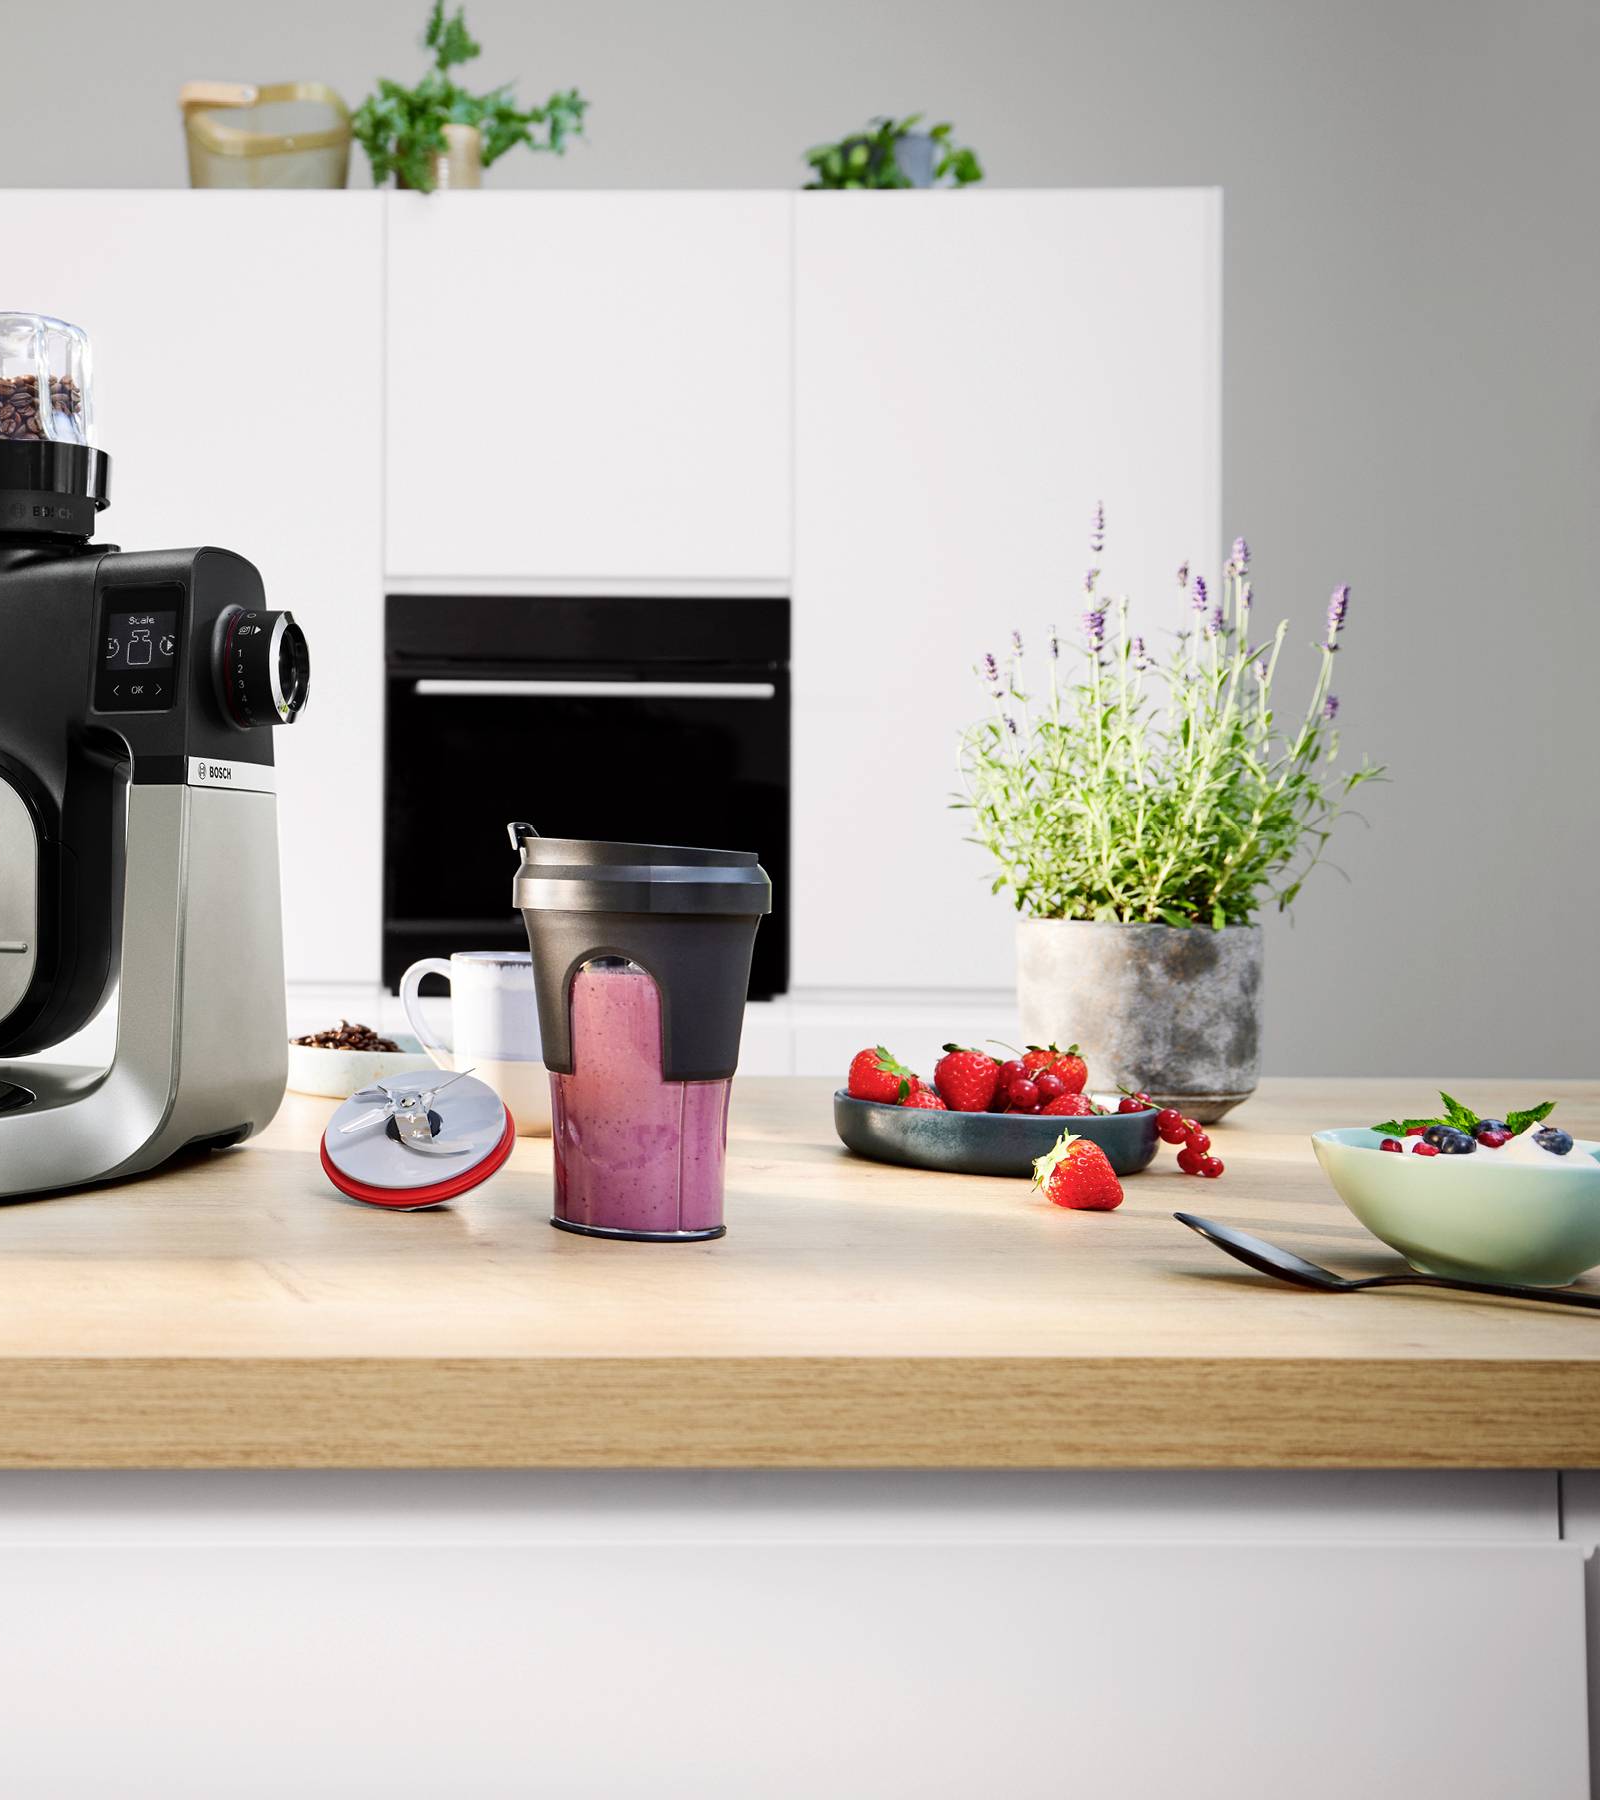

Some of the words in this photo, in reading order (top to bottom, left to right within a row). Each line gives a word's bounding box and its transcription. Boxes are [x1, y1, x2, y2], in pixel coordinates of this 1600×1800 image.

[128, 616, 155, 625] Scale
[238, 649, 243, 657] 1
[237, 664, 244, 673] 2
[238, 680, 245, 689] 3
[131, 685, 144, 694] OK
[209, 766, 232, 780] BOSCH
